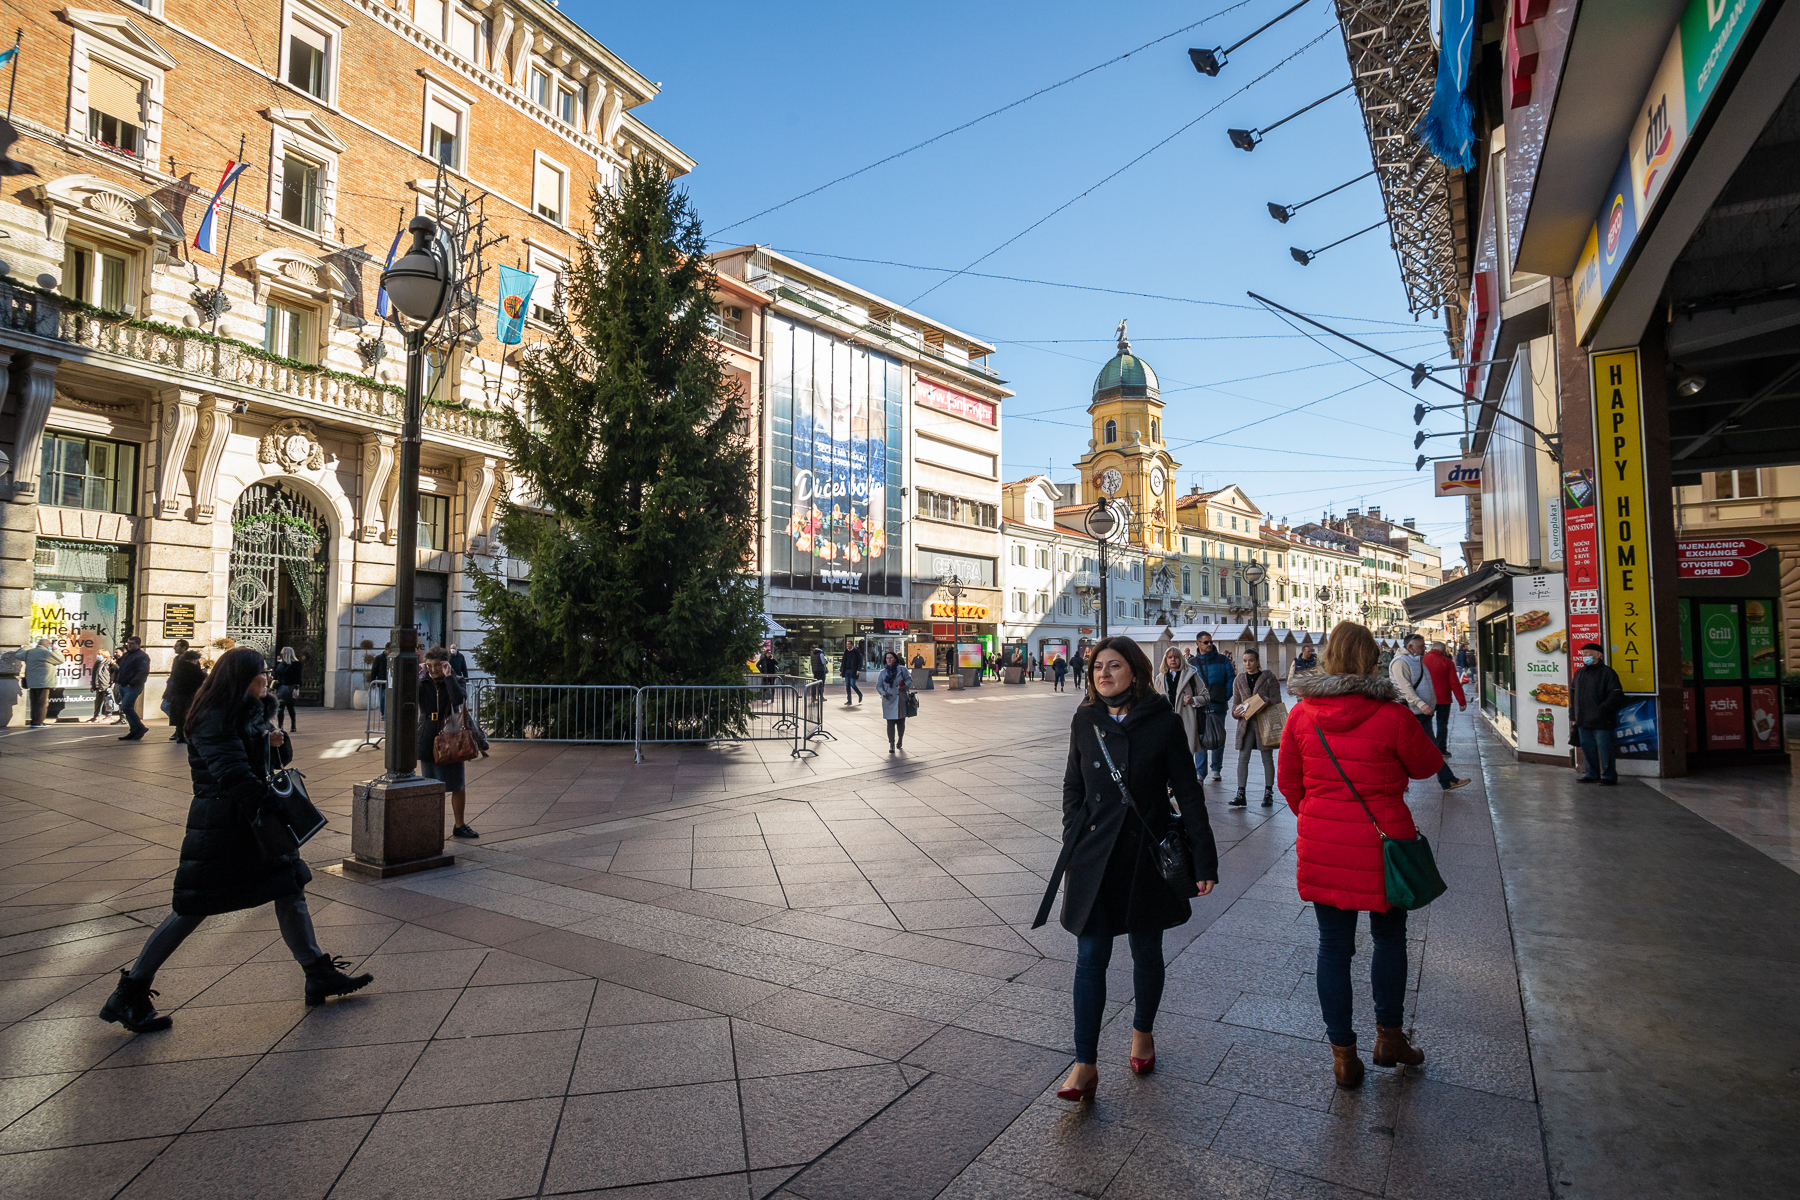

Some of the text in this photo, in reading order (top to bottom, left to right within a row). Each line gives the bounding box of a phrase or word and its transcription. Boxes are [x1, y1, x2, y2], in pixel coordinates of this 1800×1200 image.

[1697, 0, 1747, 93] DEICHMAN
[1645, 92, 1668, 166] dm
[1607, 210, 1622, 250] PEPCO
[1448, 464, 1480, 482] dm
[1610, 364, 1639, 673] HAPPY HOME 3. KAT
[1550, 504, 1560, 547] europlakat
[1580, 522, 1594, 530] STOP
[1678, 541, 1746, 550] MJENJAČNICA
[1686, 549, 1738, 557] EXCHANGE
[933, 557, 981, 580] CENTRA
[1681, 560, 1734, 568] OTVORENO
[820, 569, 862, 585] TOMMY
[41, 608, 89, 621] What
[931, 603, 989, 618] KORZO
[40, 623, 68, 635] the
[883, 619, 909, 629] TOMMY
[1708, 627, 1732, 639] Grill
[1750, 627, 1769, 635] OPEN
[52, 639, 94, 648] re we
[1527, 661, 1559, 672] Snack
[1617, 725, 1643, 738] BAR
[1620, 743, 1649, 753] BAR
